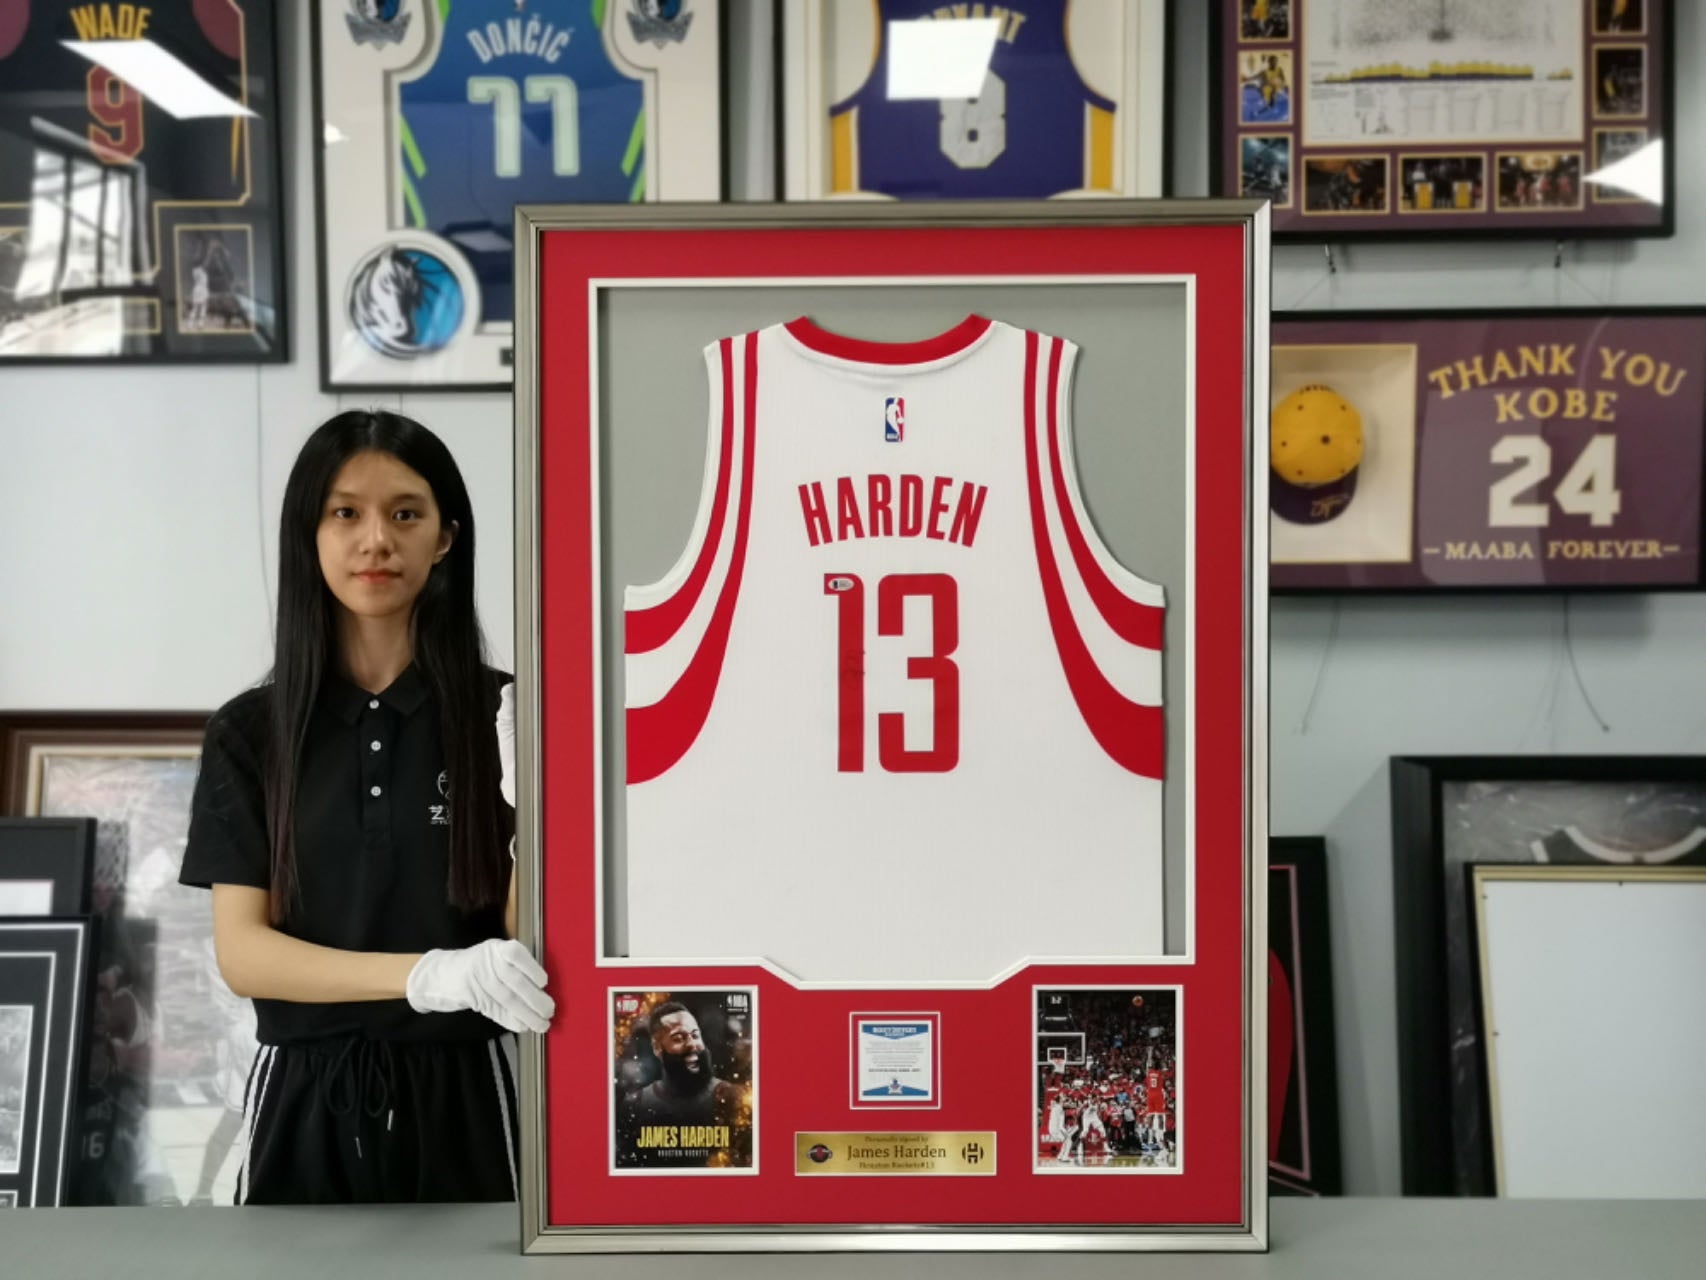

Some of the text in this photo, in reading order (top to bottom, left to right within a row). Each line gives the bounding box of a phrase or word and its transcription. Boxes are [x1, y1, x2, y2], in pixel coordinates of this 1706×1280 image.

[466, 14, 575, 64] DONČIĆ
[87, 62, 144, 165] 9
[467, 75, 580, 178] 77
[1429, 344, 1687, 399] THANK YOU
[1494, 387, 1618, 422] KOBE
[798, 474, 988, 547] HARDEN
[1489, 434, 1621, 527] 24
[824, 573, 959, 773] 13
[636, 1126, 729, 1148] JAMES HARDEN
[847, 1145, 946, 1160] James Harden
